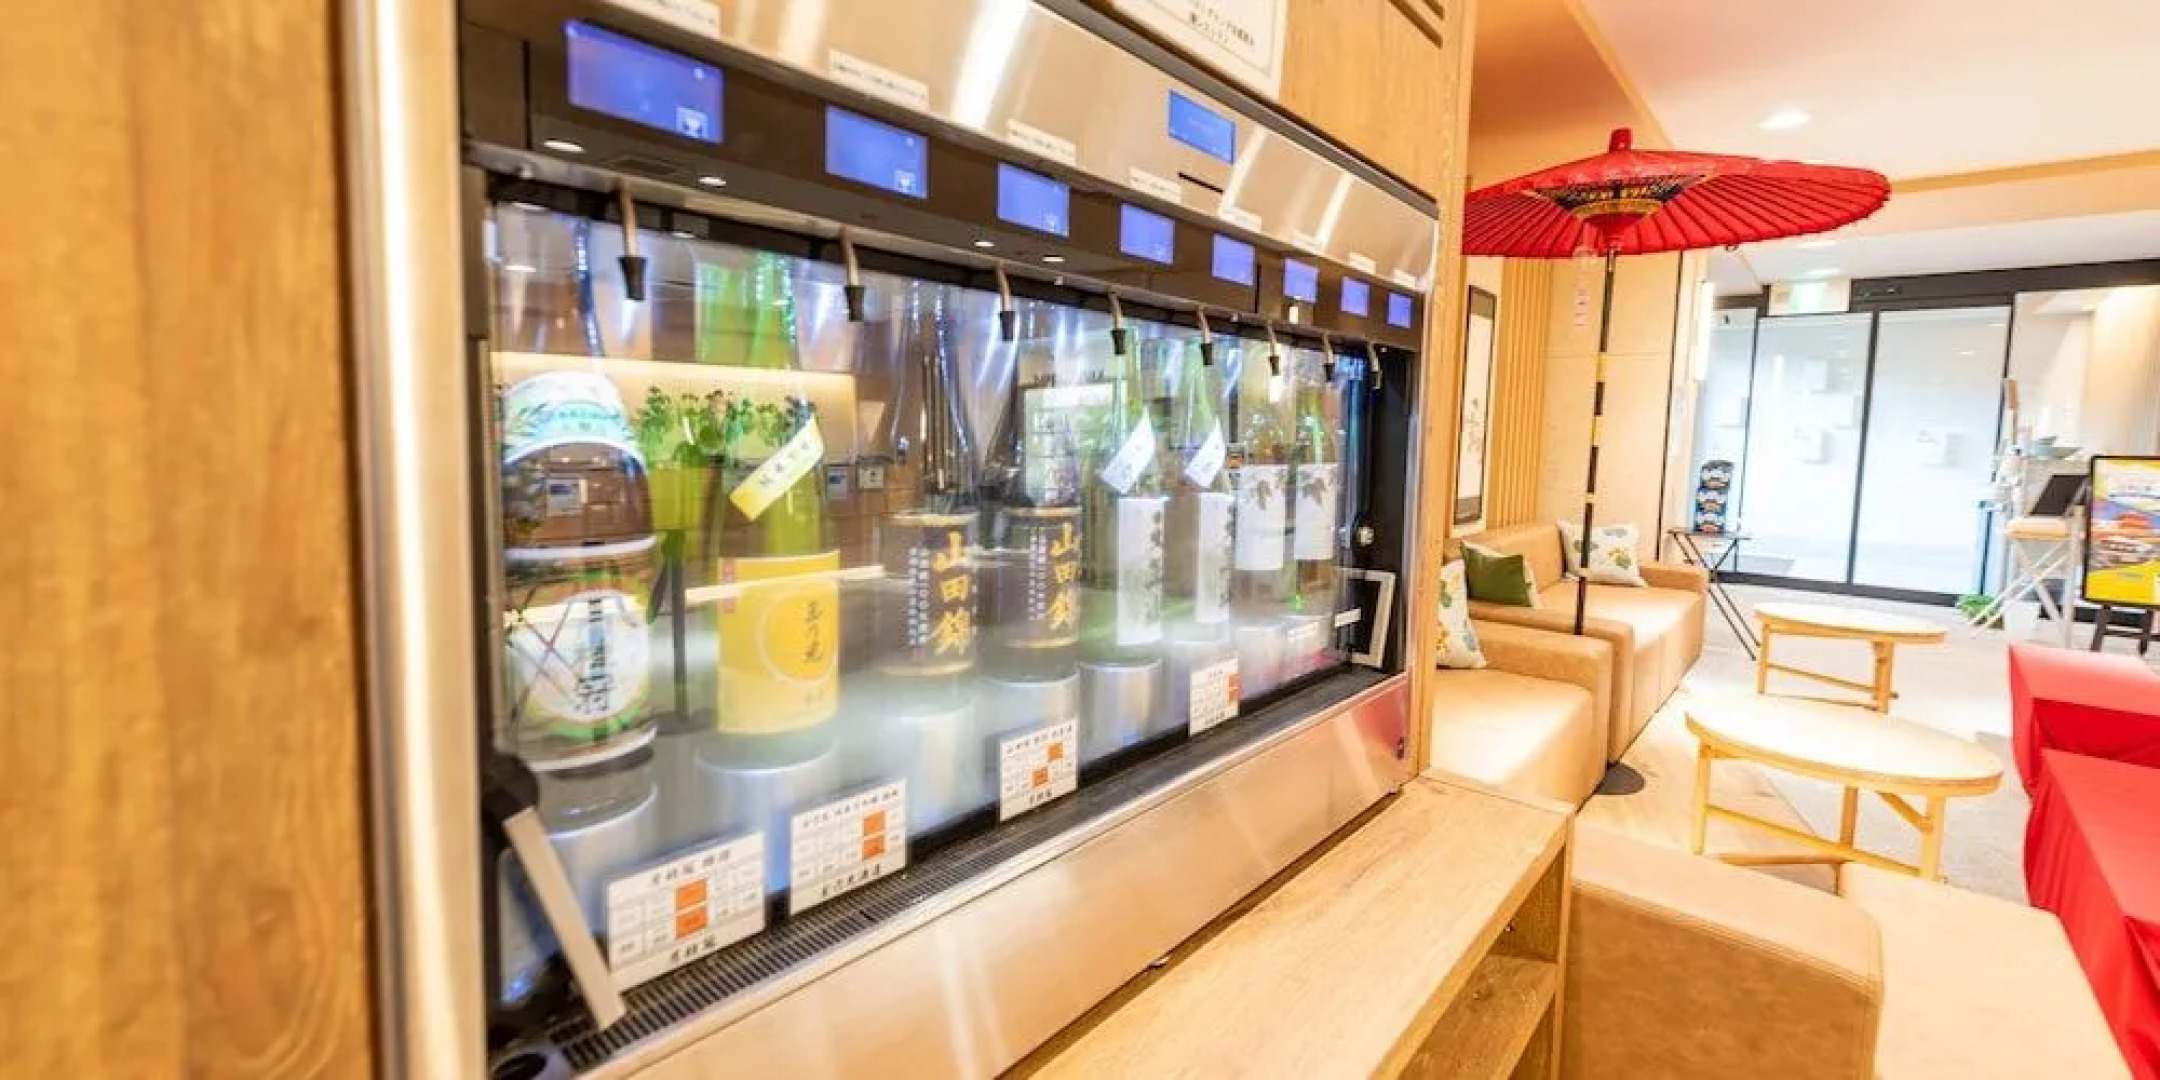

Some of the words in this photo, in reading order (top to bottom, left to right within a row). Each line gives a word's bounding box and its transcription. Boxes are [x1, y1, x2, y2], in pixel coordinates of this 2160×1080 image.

[932, 530, 972, 656] 山田錦
[1050, 521, 1082, 631] 山田錦
